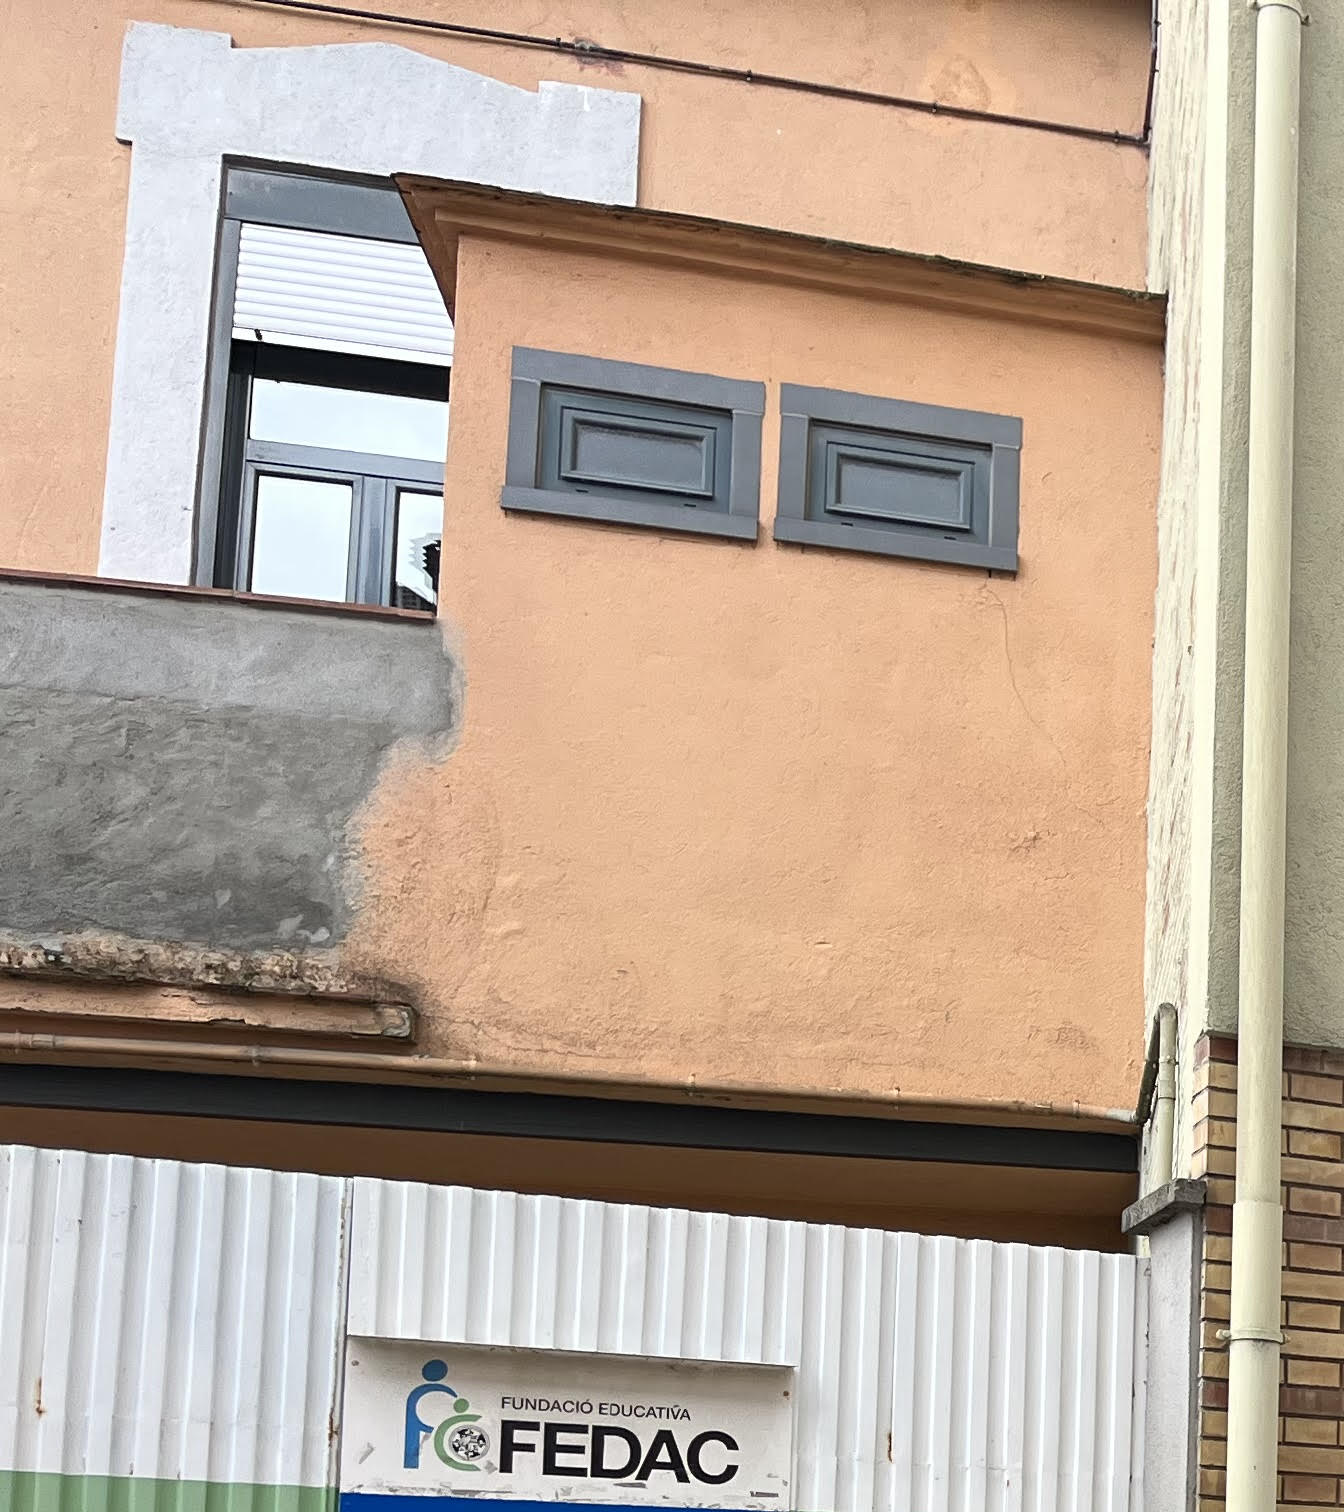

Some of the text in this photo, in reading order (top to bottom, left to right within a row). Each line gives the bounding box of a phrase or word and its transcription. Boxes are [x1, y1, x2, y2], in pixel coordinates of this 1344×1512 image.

[500, 1396, 692, 1421] FUNDACIÓ EDUCATIVA
[498, 1419, 740, 1485] FEDAC
